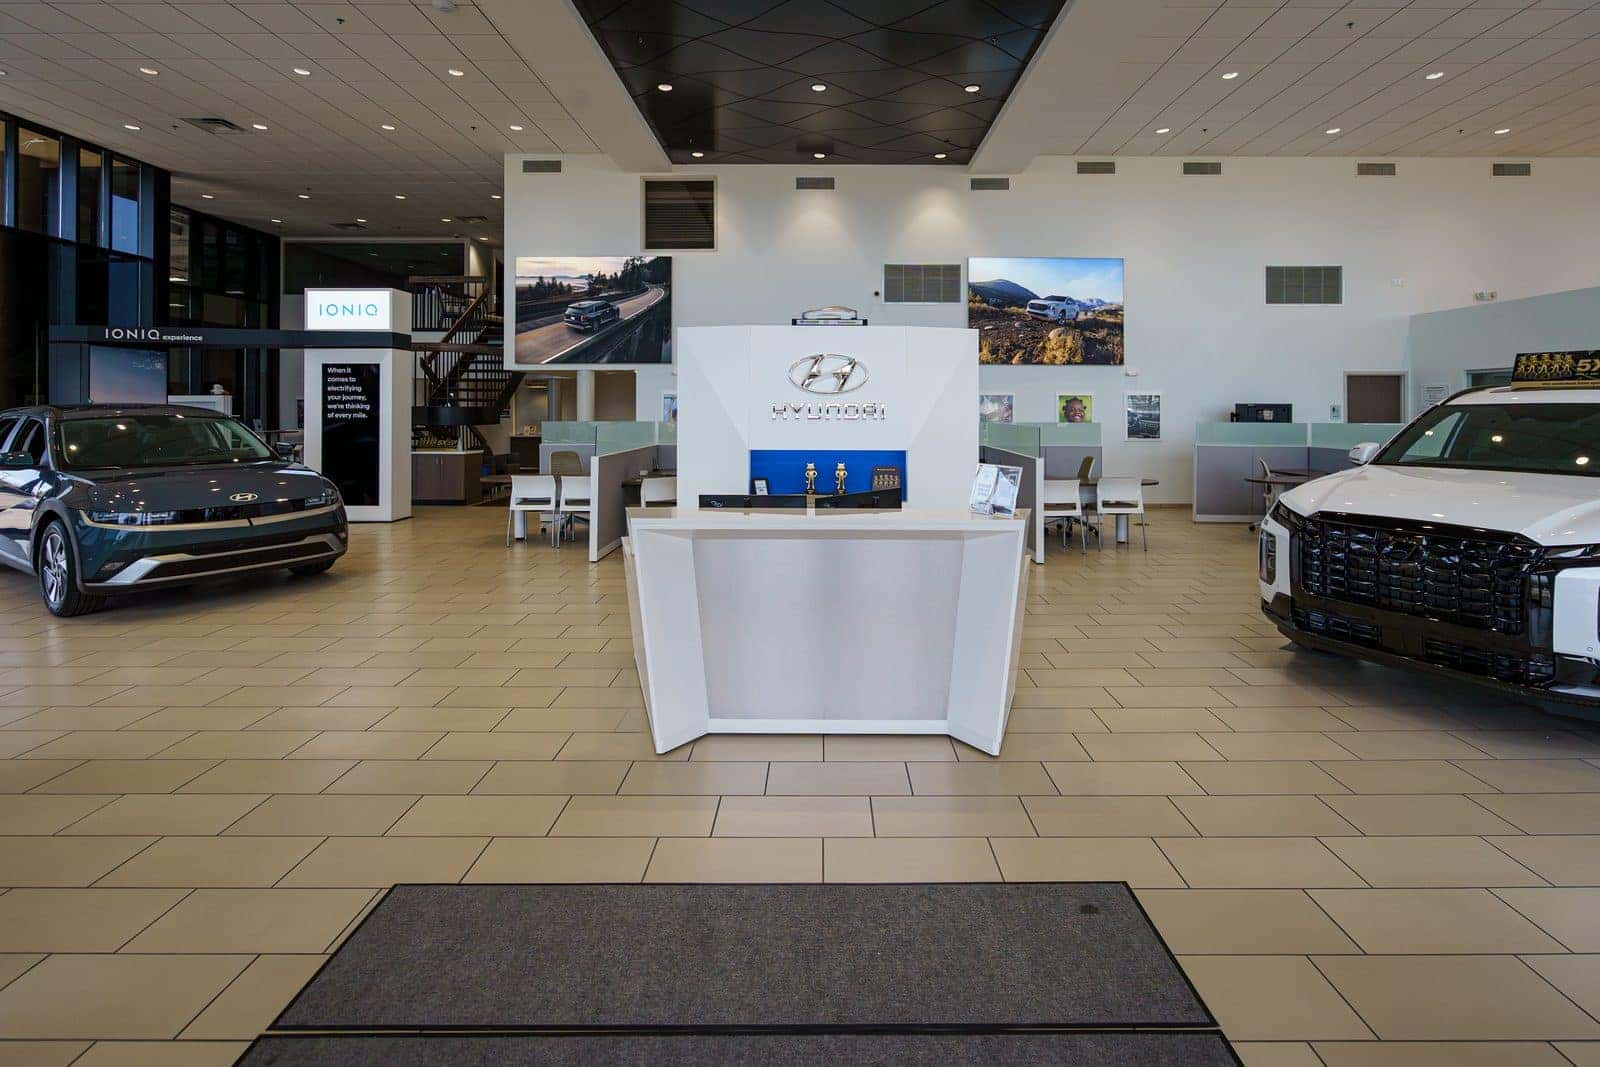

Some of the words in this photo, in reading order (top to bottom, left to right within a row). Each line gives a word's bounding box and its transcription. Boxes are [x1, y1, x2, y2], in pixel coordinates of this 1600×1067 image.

[319, 303, 379, 317] IONIQ
[105, 328, 160, 340] IONIQ
[162, 334, 203, 342] experience
[328, 385, 363, 393] electrifying
[345, 403, 370, 411] thinking
[771, 402, 886, 420] HYUNDAI
